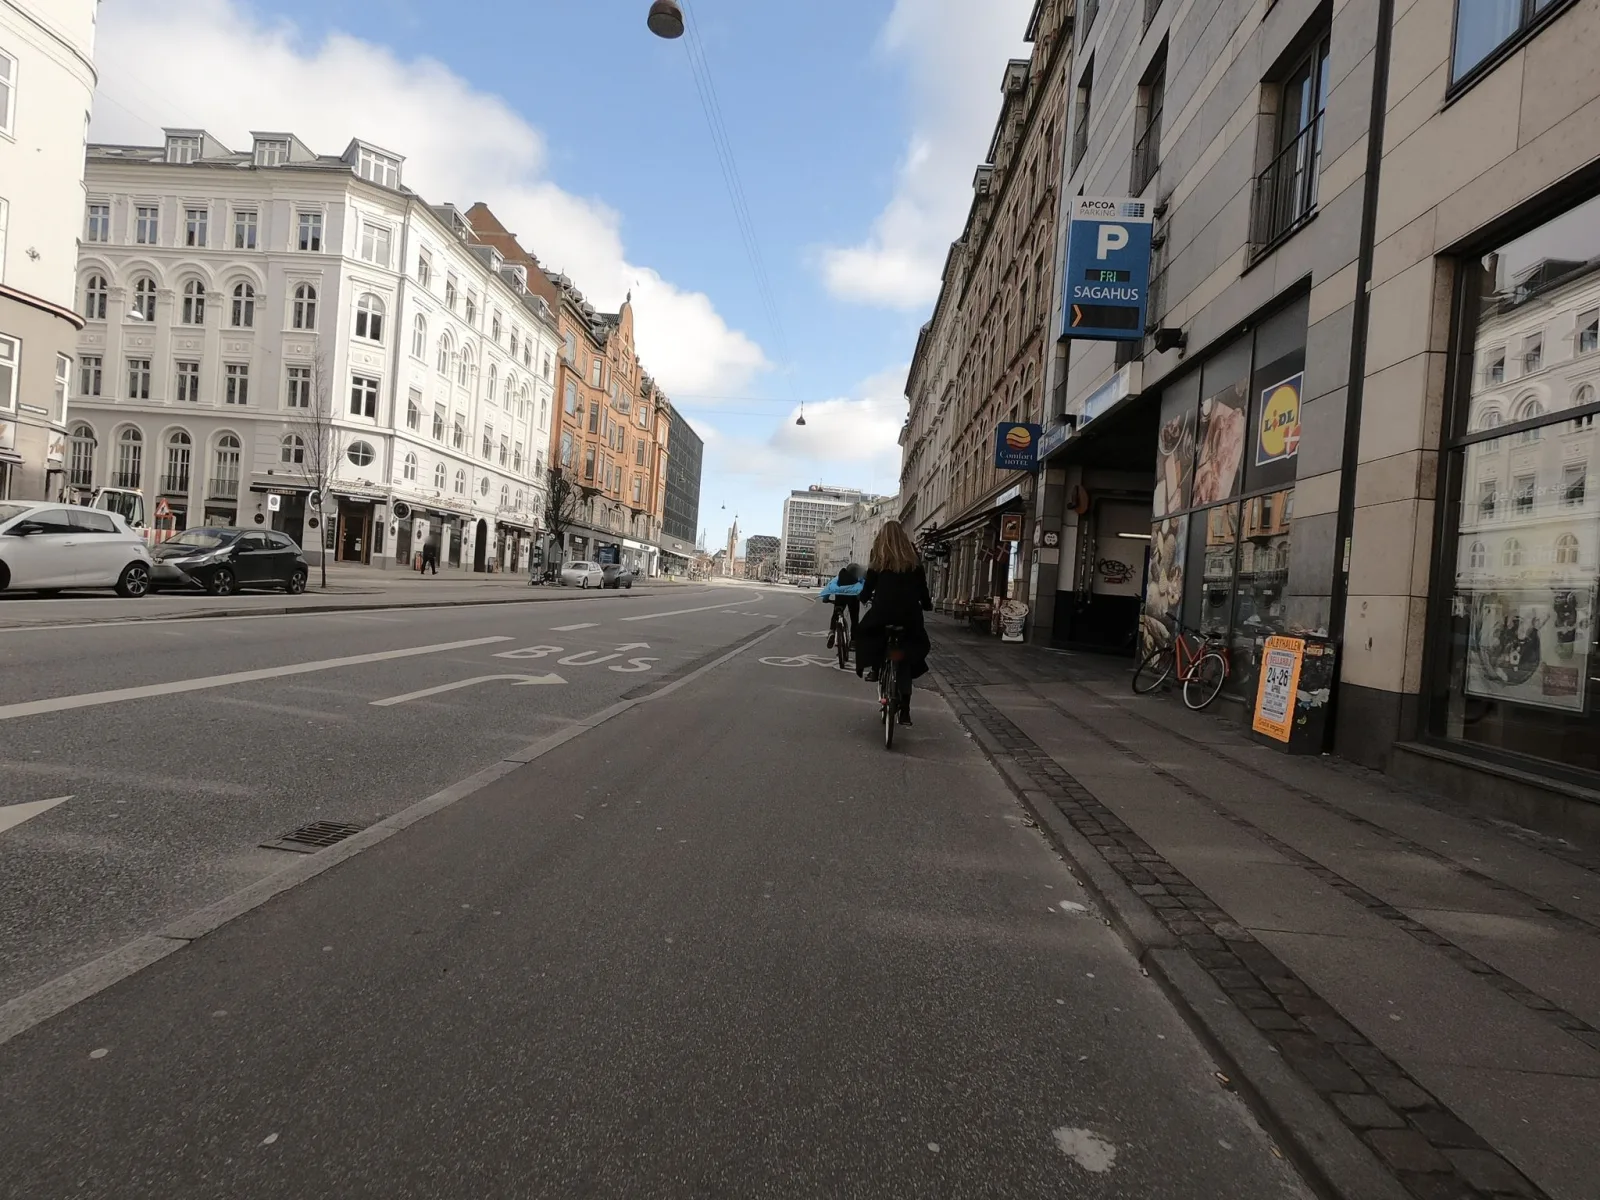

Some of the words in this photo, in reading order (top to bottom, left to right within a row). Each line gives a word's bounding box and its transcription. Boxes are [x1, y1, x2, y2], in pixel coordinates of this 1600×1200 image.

[1081, 201, 1115, 210] APCOA
[1079, 208, 1116, 217] PARKING
[1096, 224, 1129, 260] P
[1100, 271, 1116, 283] FRI
[1073, 285, 1139, 301] SAGAHUS
[999, 450, 1033, 461] Comfort
[491, 644, 661, 673] BUS
